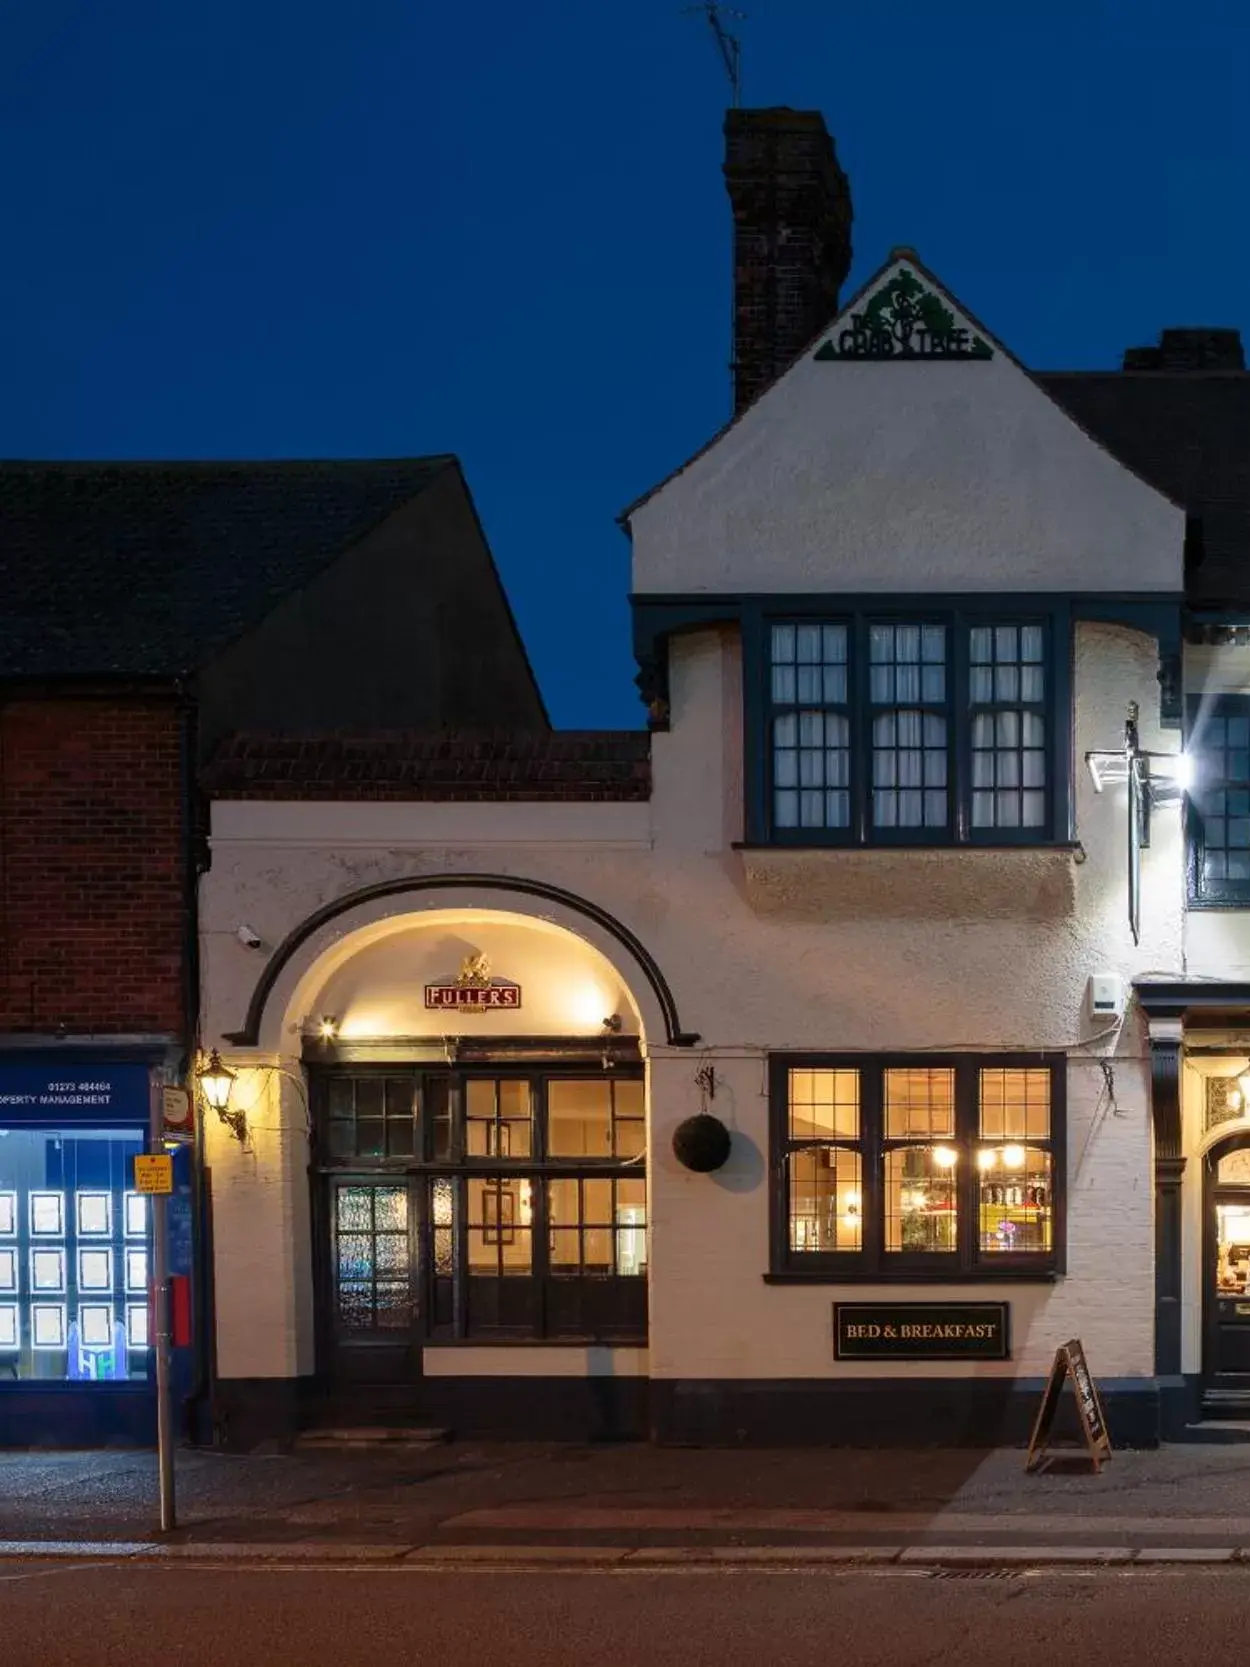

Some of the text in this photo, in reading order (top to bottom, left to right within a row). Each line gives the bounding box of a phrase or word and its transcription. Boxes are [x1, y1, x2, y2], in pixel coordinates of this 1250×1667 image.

[430, 988, 513, 1004] FULLER'S
[40, 1094, 110, 1104] MANAGEMENT
[846, 1325, 996, 1338] BED & BREAKFAST
